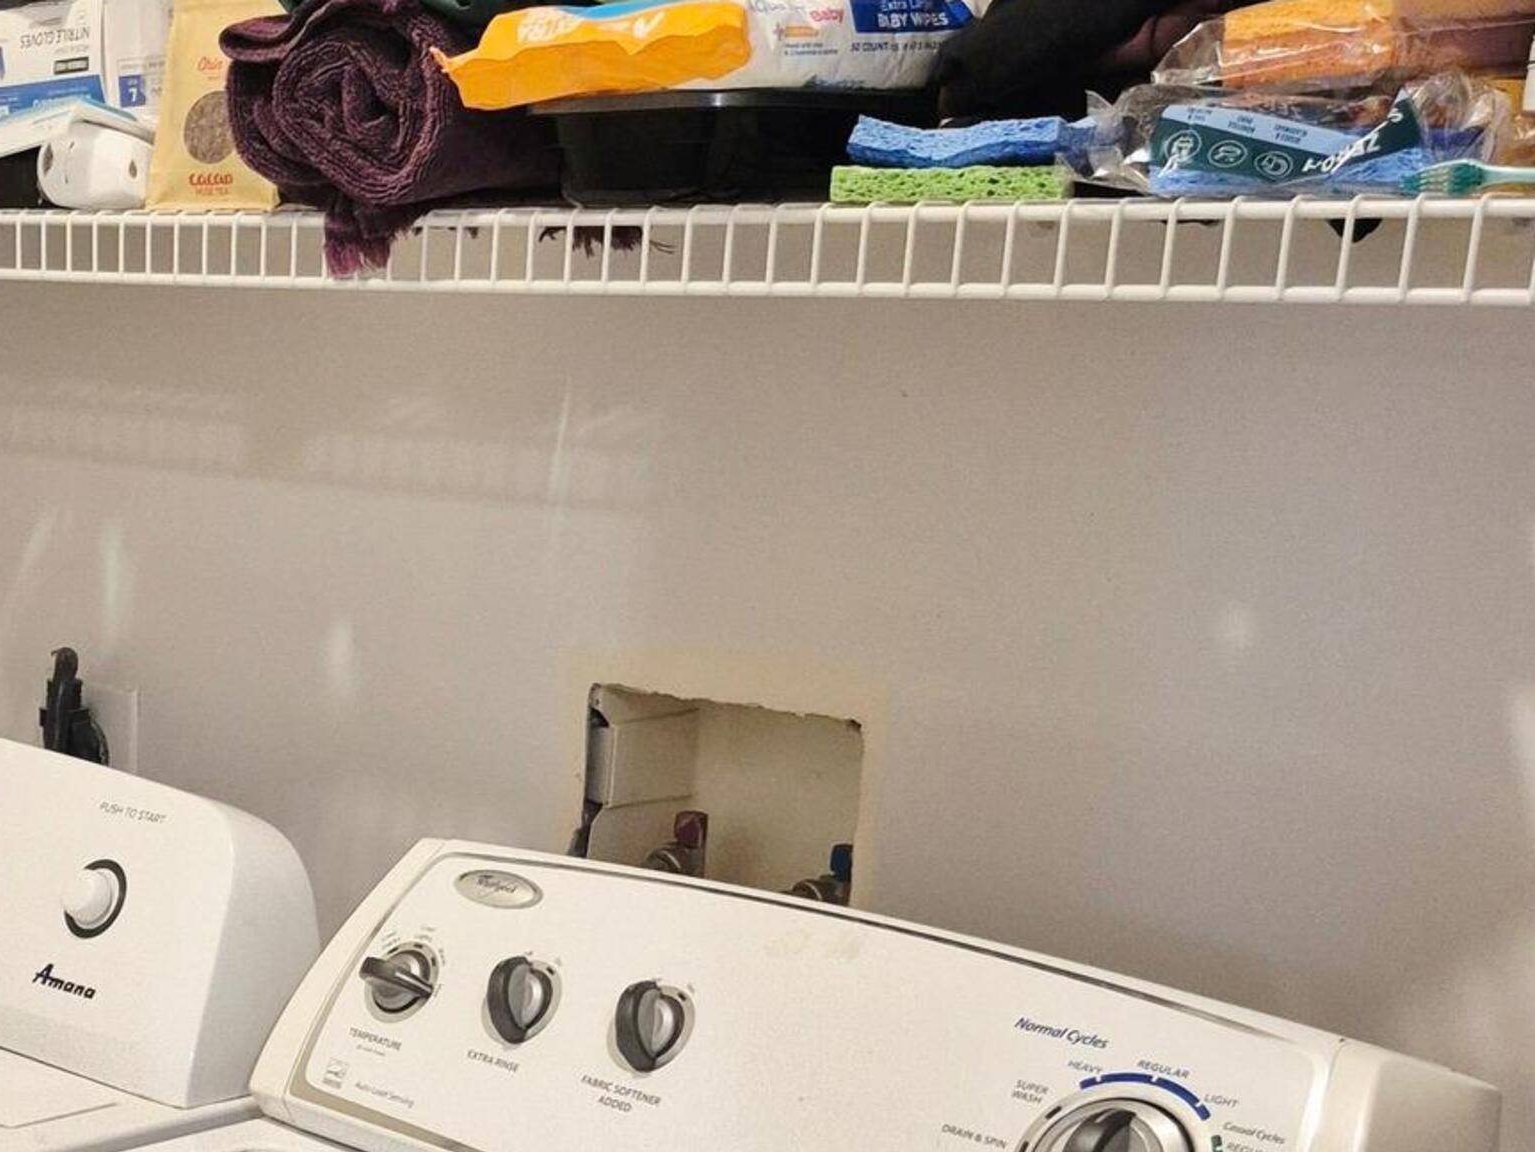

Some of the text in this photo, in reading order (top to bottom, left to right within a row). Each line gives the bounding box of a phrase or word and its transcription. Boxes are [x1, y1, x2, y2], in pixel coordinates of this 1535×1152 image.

[877, 12, 949, 28] BABY WIPES
[19, 31, 56, 50] GLOVES
[100, 801, 167, 824] PUSH TO START
[32, 963, 96, 999] Amana
[348, 1027, 403, 1052] TEMPERATURE
[1014, 1017, 1109, 1050] Normal Cycles
[467, 1050, 520, 1073] EXTRA RINSE
[1067, 1060, 1104, 1075] HEAVY
[1136, 1059, 1190, 1080] REGULAR
[580, 1074, 662, 1107] FABRIC SOFTENER
[1011, 1090, 1043, 1105] WASH
[1016, 1079, 1049, 1095] SUPER
[597, 1094, 633, 1113] ADDED
[1203, 1093, 1239, 1108] LIGHT
[941, 1123, 1008, 1150] DRAIN & SPIN
[1223, 1121, 1286, 1145] Casual Cycles
